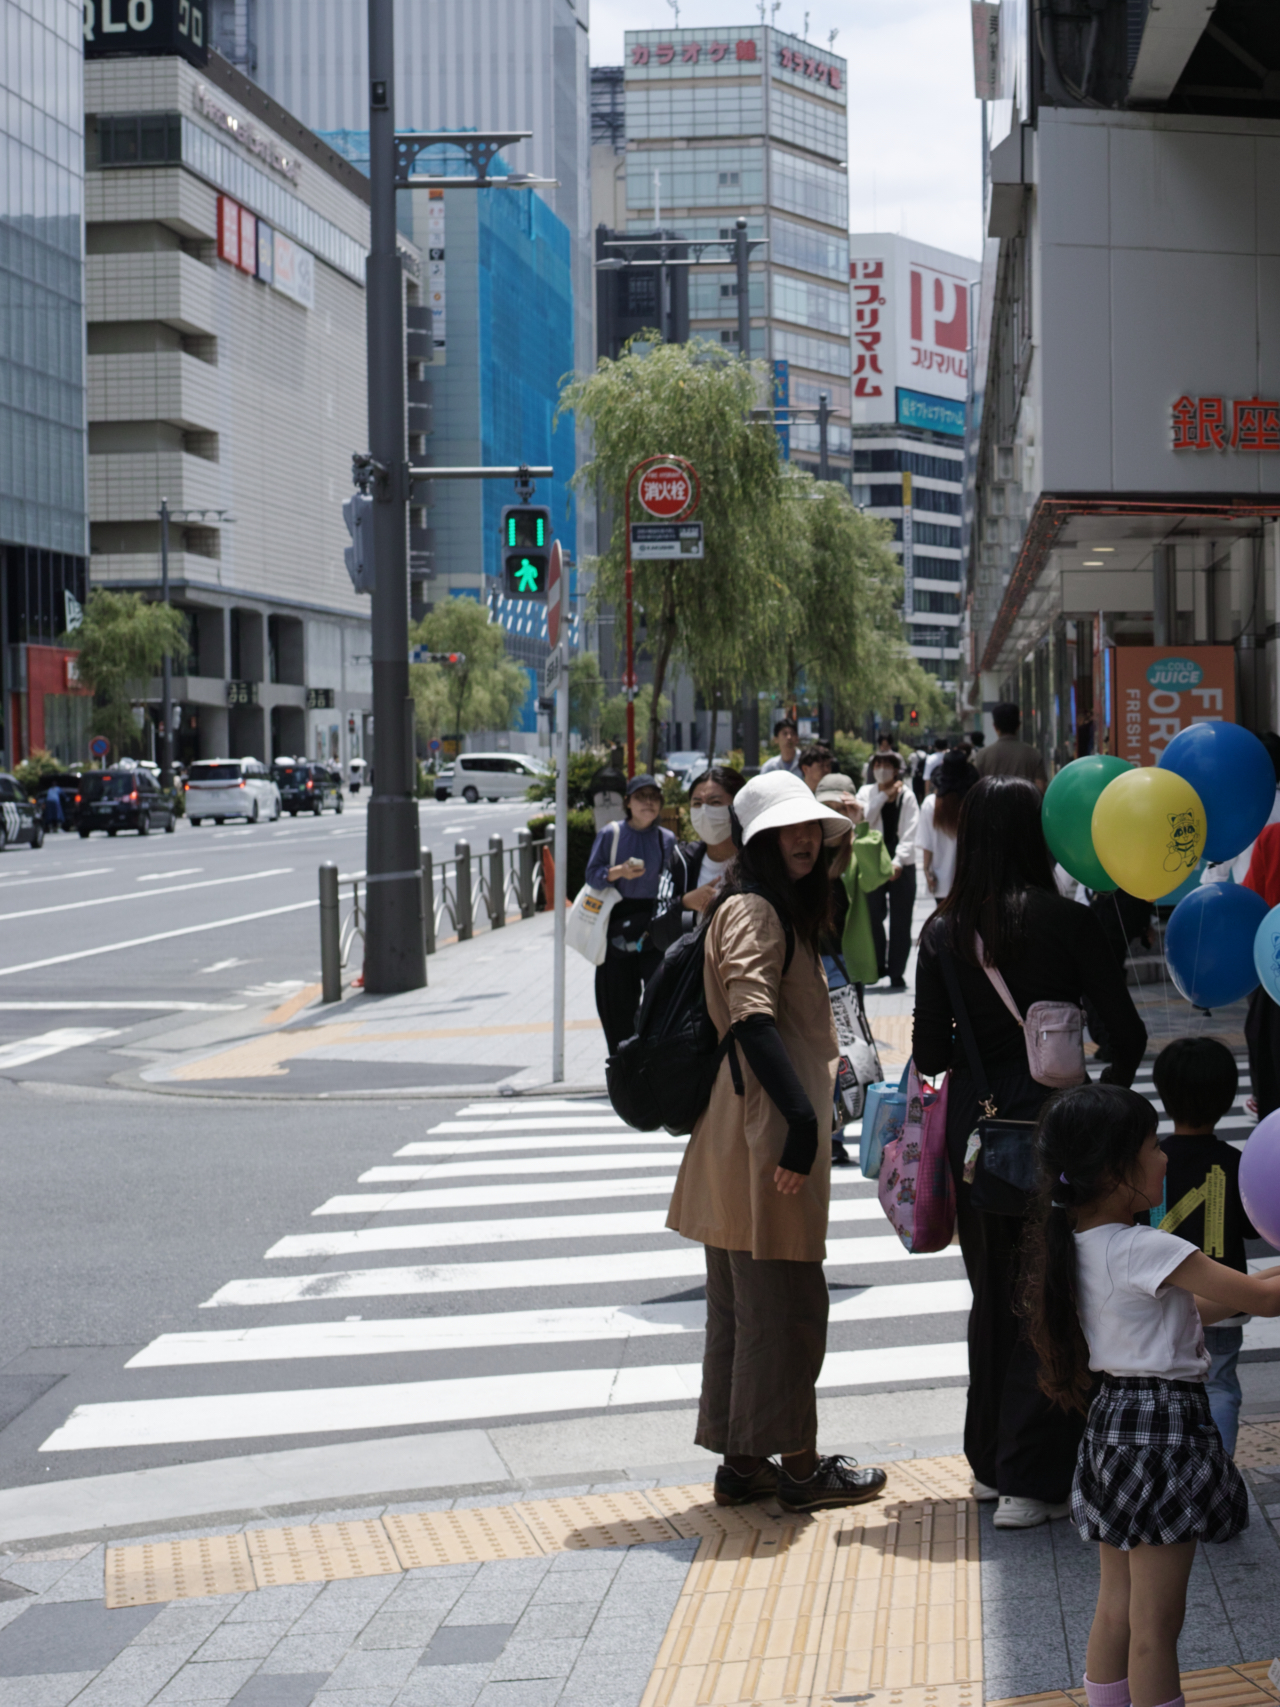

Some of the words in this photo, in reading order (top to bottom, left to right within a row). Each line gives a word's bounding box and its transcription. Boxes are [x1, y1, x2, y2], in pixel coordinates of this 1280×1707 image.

[631, 39, 758, 65] カラオケ館
[853, 284, 887, 398] プリマハム
[910, 346, 969, 379] プリマハム
[644, 480, 687, 501] 消火栓
[1150, 671, 1200, 684] JUICE
[1167, 661, 1194, 671] COLD
[1126, 688, 1141, 747] FRESH
